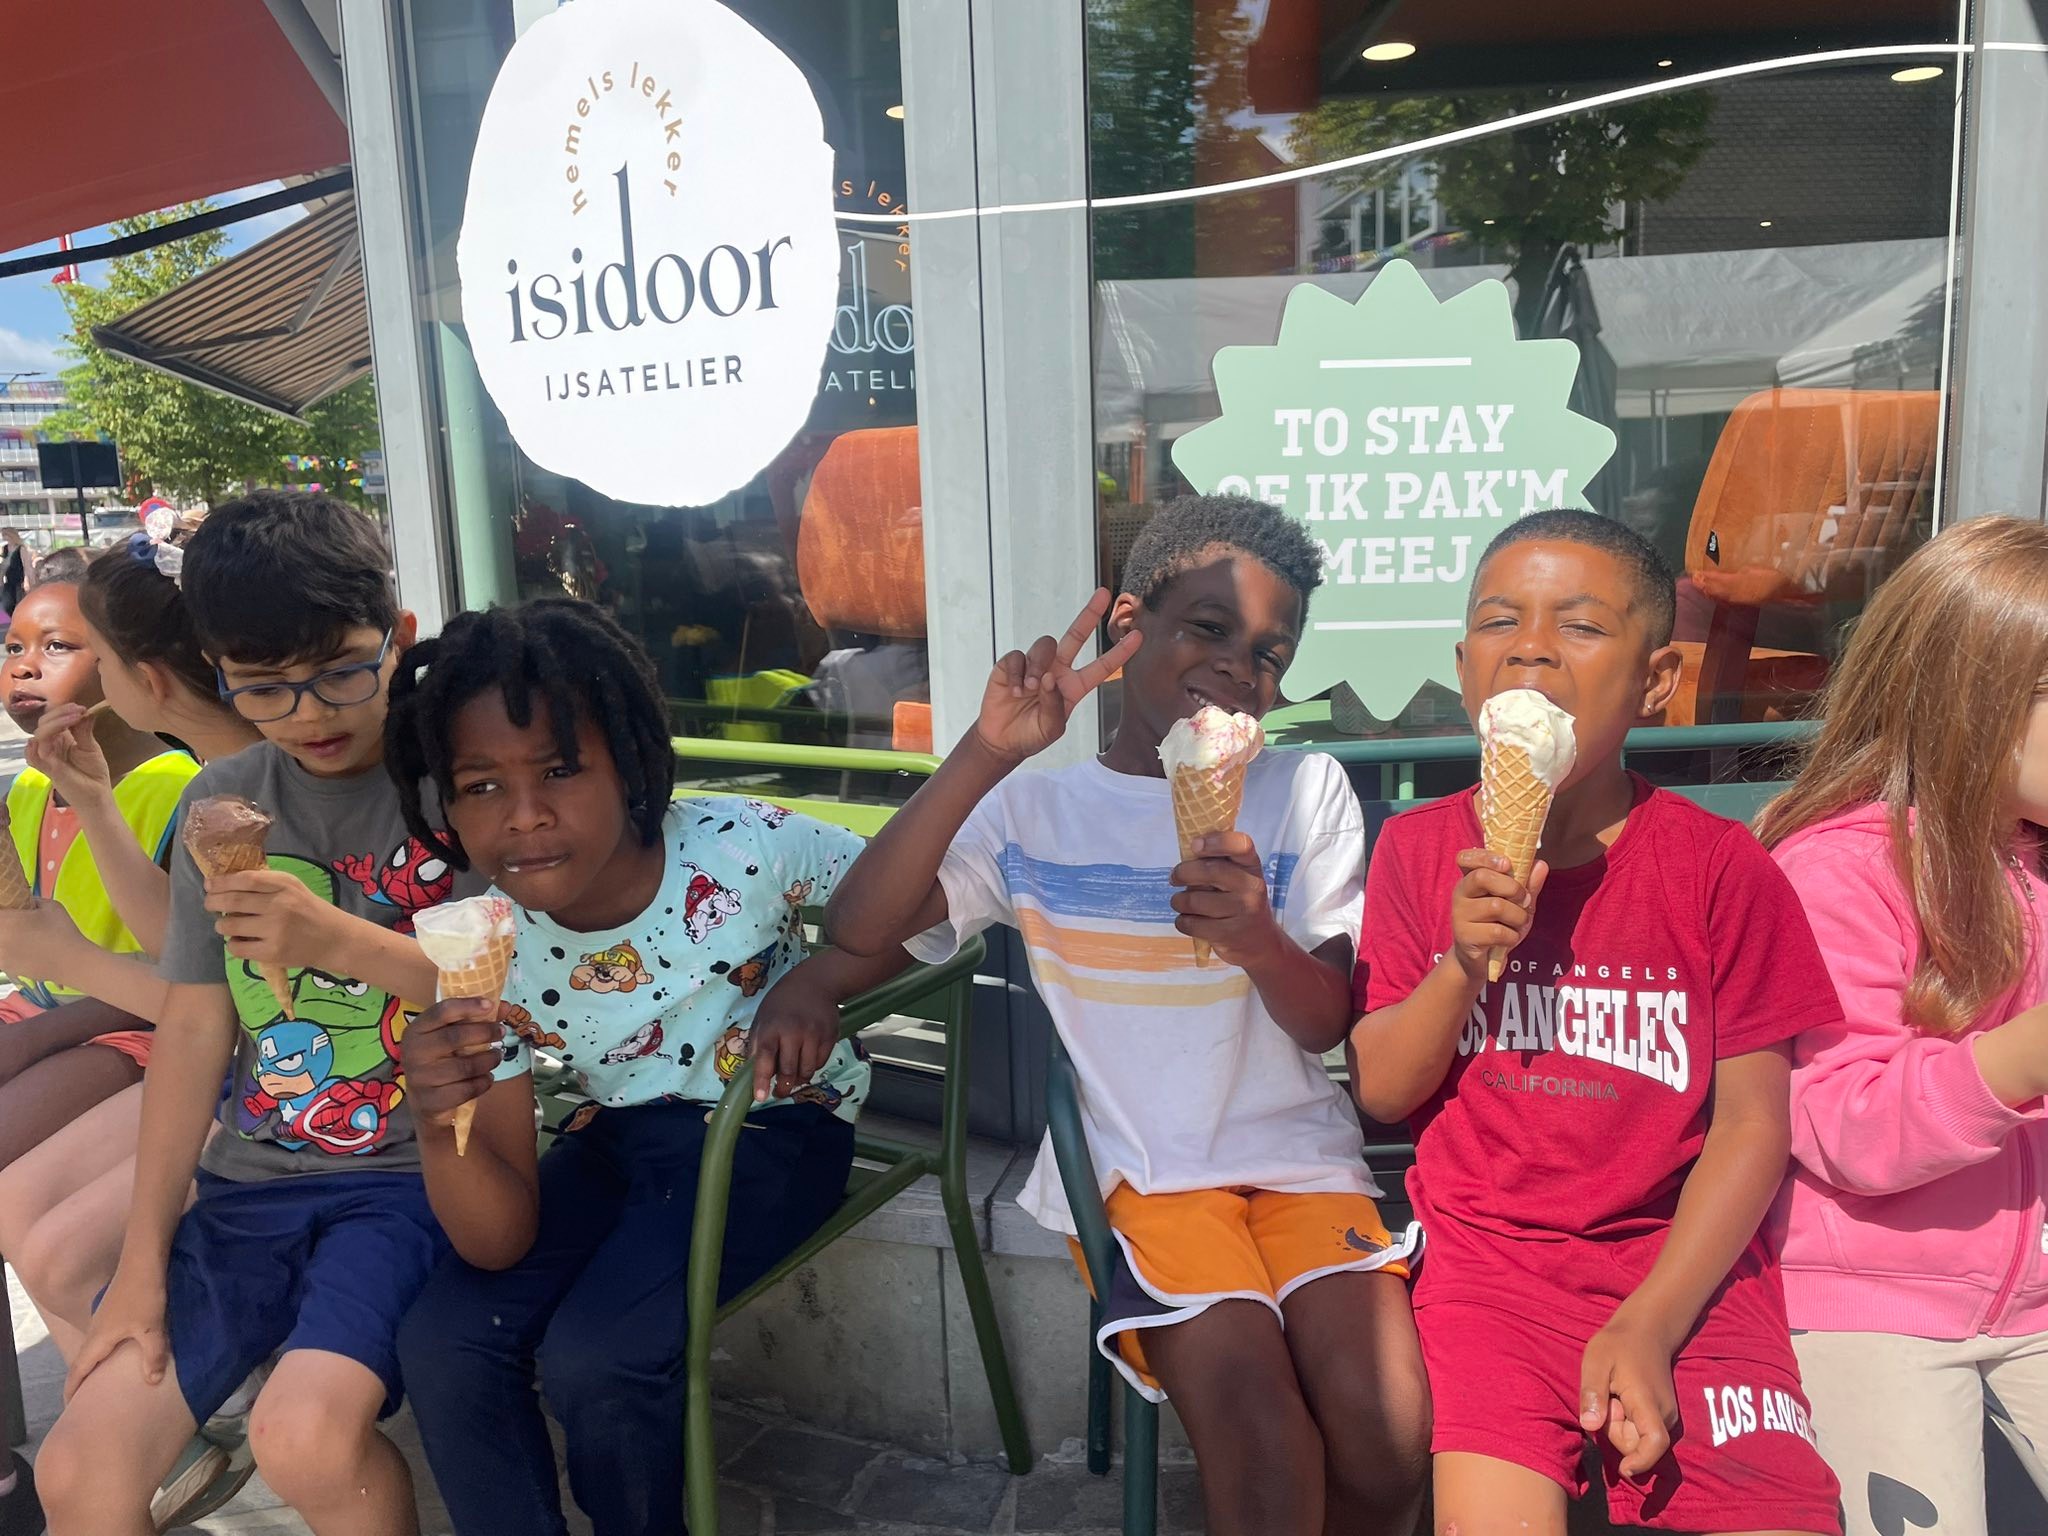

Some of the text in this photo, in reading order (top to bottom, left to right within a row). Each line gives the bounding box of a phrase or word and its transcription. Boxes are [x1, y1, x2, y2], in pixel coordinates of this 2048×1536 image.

[563, 62, 683, 215] hemels lekker
[504, 160, 793, 343] isidoor
[545, 354, 743, 402] IJSATELIER
[824, 368, 916, 392] ATELI
[1274, 404, 1514, 457] TO STAY
[1305, 473, 1368, 521] IK
[1384, 468, 1569, 520] PAK'M
[1510, 959, 1678, 980] OF ANGELS
[1495, 981, 1691, 1094] ANGELES
[1481, 1070, 1620, 1102] CALIFORNIA
[1703, 1384, 1757, 1448] LOS
